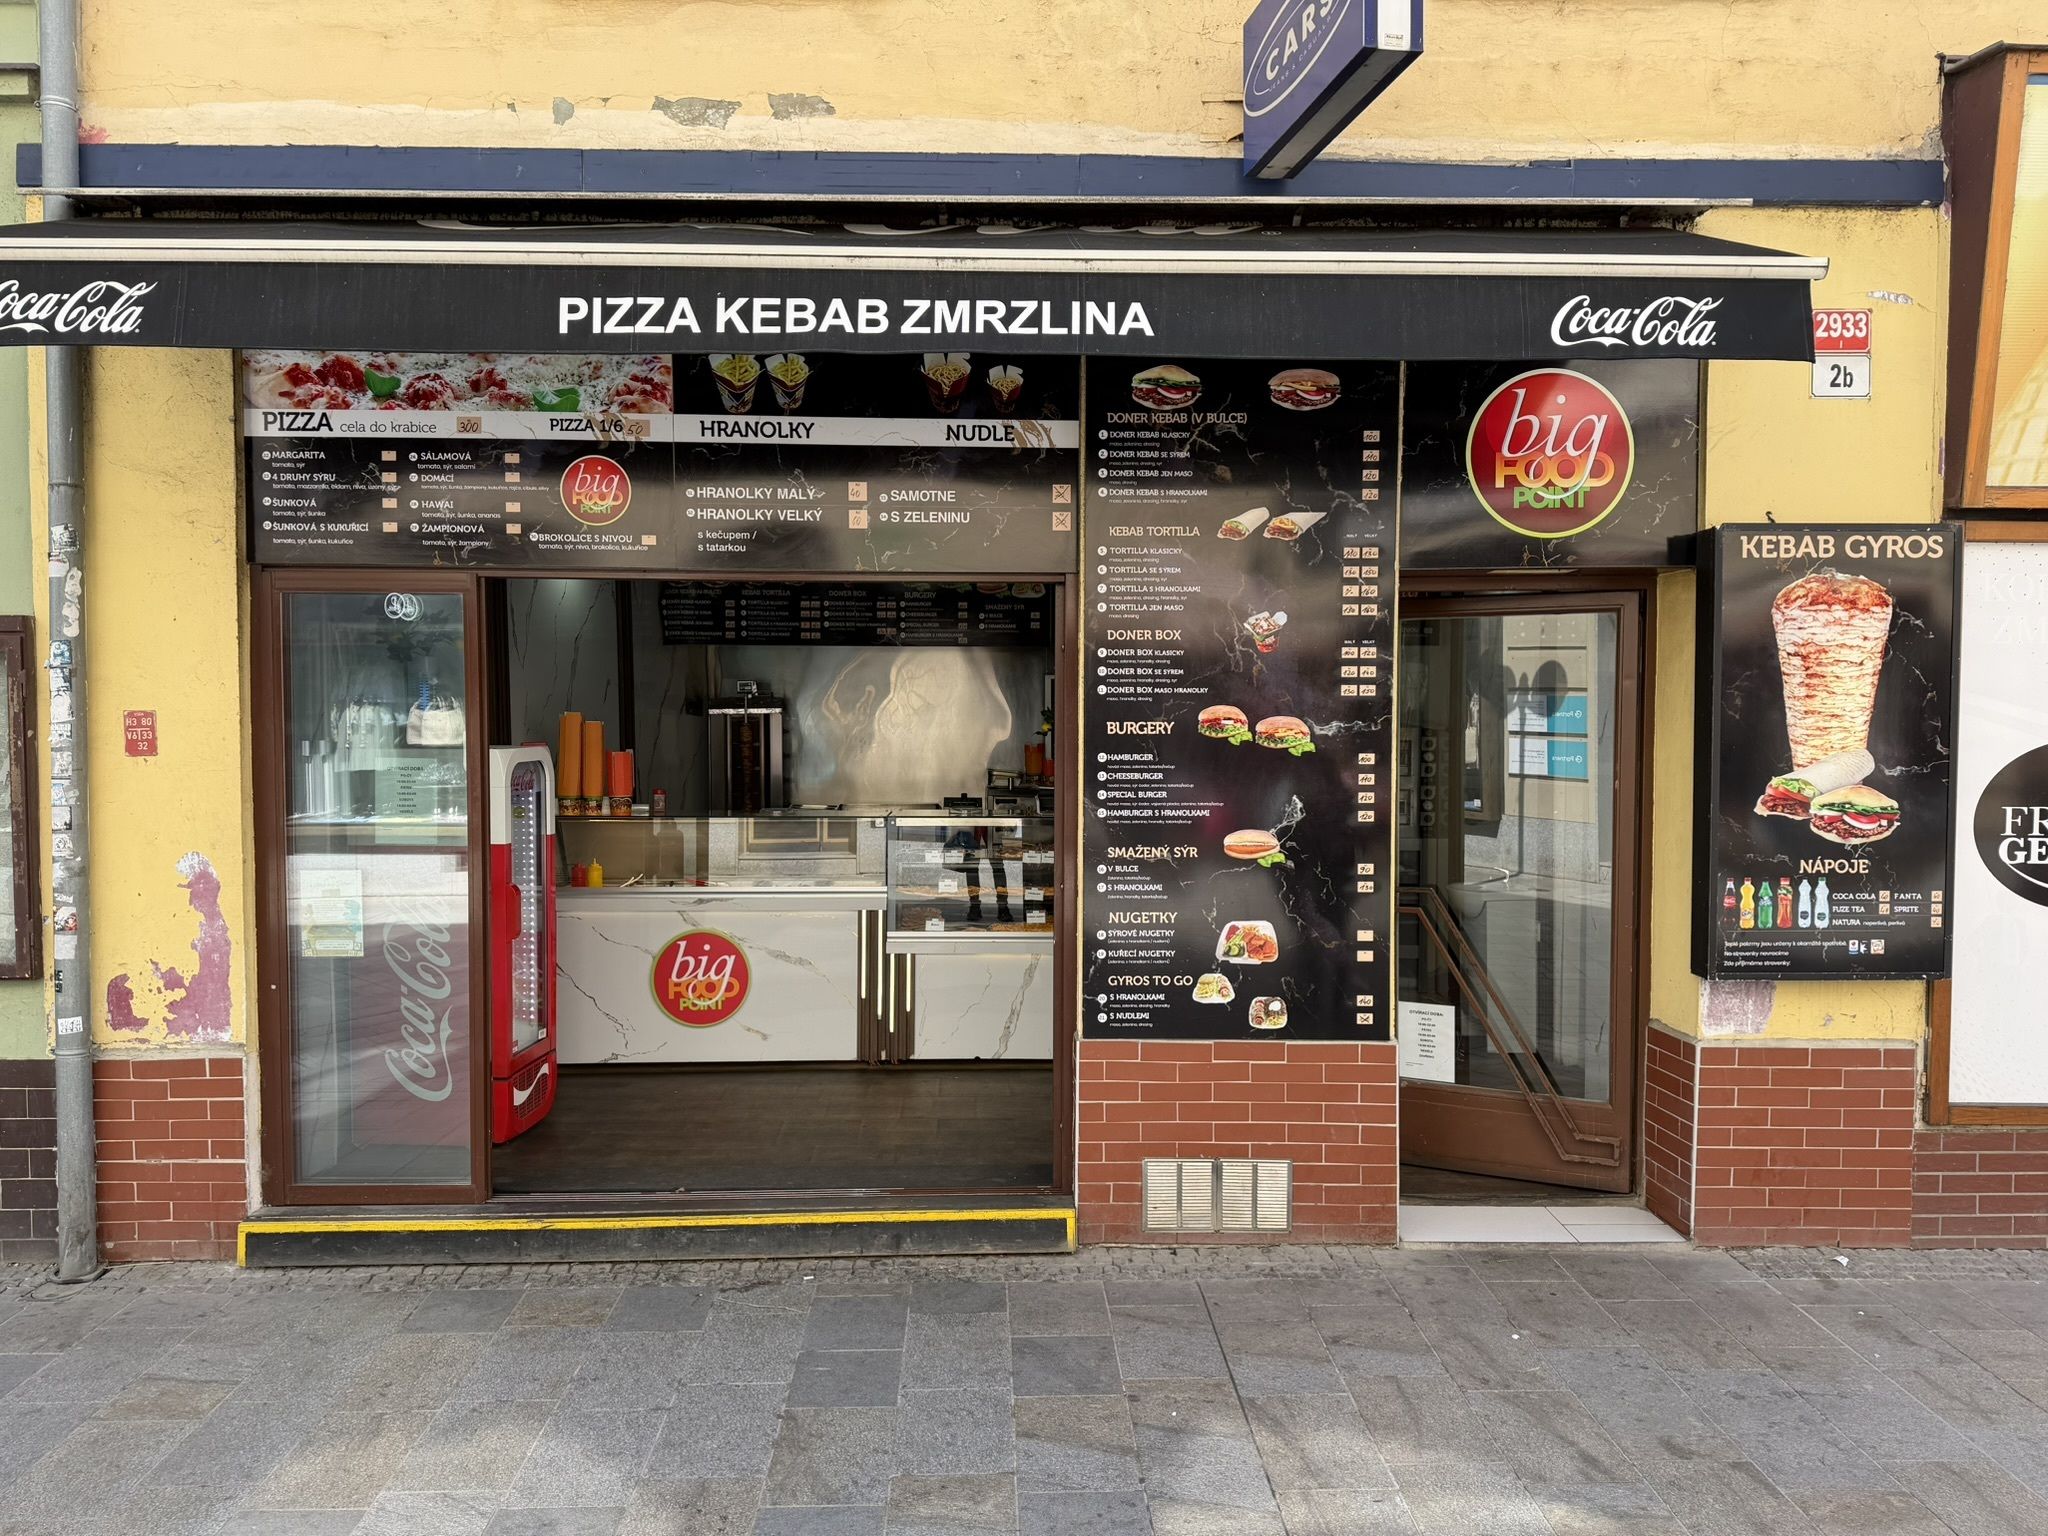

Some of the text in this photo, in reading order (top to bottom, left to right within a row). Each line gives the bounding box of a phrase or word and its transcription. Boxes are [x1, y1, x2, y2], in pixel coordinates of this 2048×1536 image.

[559, 297, 1154, 336] PIZZA KEBAB ZMRZLINA
[1551, 294, 1724, 347] Coca-Cola
[1816, 313, 1867, 337] 2933
[1830, 364, 1853, 387] 2b
[262, 411, 437, 433] PIZZA cela do krabice
[1107, 412, 1248, 425] DONER KEBAB (V BULCE)
[459, 421, 479, 433] 300
[550, 418, 623, 432] PIZZA 1/6
[627, 423, 643, 435] 50
[700, 420, 815, 439] HRANOLKY
[945, 425, 1015, 442] NUDLE
[1501, 388, 1608, 499] big
[272, 451, 326, 460] MARGARITA
[421, 451, 472, 461] SÁLAMOVÁ
[1110, 450, 1135, 458] DONER
[1137, 450, 1159, 458] KEBAB
[1495, 452, 1615, 488] FOOD
[272, 471, 336, 482] 4 DRUHY SÝRU
[574, 463, 620, 510] big
[1109, 488, 1135, 496] DONER
[1136, 488, 1159, 496] KEBAB
[696, 486, 815, 500] HRANOLKY MALÝ
[890, 490, 956, 502] SAMOTNE
[1514, 486, 1591, 509] POINT
[272, 497, 317, 508] ŠUNKOVÁ
[422, 501, 454, 509] HAWAI
[697, 507, 822, 522] HRANOLKY VELKÝ
[890, 511, 970, 524] S ZELENINU
[272, 522, 317, 532] ŠUNKOVÁ
[320, 524, 325, 532] S
[422, 523, 485, 533] ŽAMPIONOVÁ
[1109, 526, 1200, 537] KEBAB TORTILLA
[539, 533, 633, 544] BROKOLICE S NIVOU
[706, 530, 750, 542] kečupem
[698, 543, 746, 552] s tatarkou
[1109, 547, 1148, 555] TORTILLA
[1740, 535, 1944, 559] KEBAB GYROS
[1109, 566, 1148, 574] TORTILLA
[1107, 630, 1182, 640] DONER BOX
[1107, 686, 1135, 694] DONER
[1136, 686, 1153, 694] BOX
[126, 717, 152, 726] H3 80
[1107, 721, 1175, 735] BURGERY
[141, 730, 153, 739] 33
[137, 741, 148, 750] 32
[1107, 753, 1154, 761] HAMBURGER
[1107, 772, 1164, 780] CHEESEBURGER
[1107, 791, 1136, 799] SPECIAL
[1107, 809, 1153, 817] HAMBURGER
[1161, 809, 1210, 817] HRANOLKAMI
[1107, 844, 1198, 858] SMAŽENÝ SÝR
[1115, 865, 1139, 873] BULCE
[1799, 856, 1869, 874] NÁPOJE
[1108, 912, 1178, 924] NUGETKY
[1108, 928, 1138, 937] SÝROVÉ
[671, 940, 736, 1005] big
[1108, 975, 1193, 986] GYROS TO GO
[668, 977, 740, 1000] FOOD
[680, 997, 726, 1011] POINT
